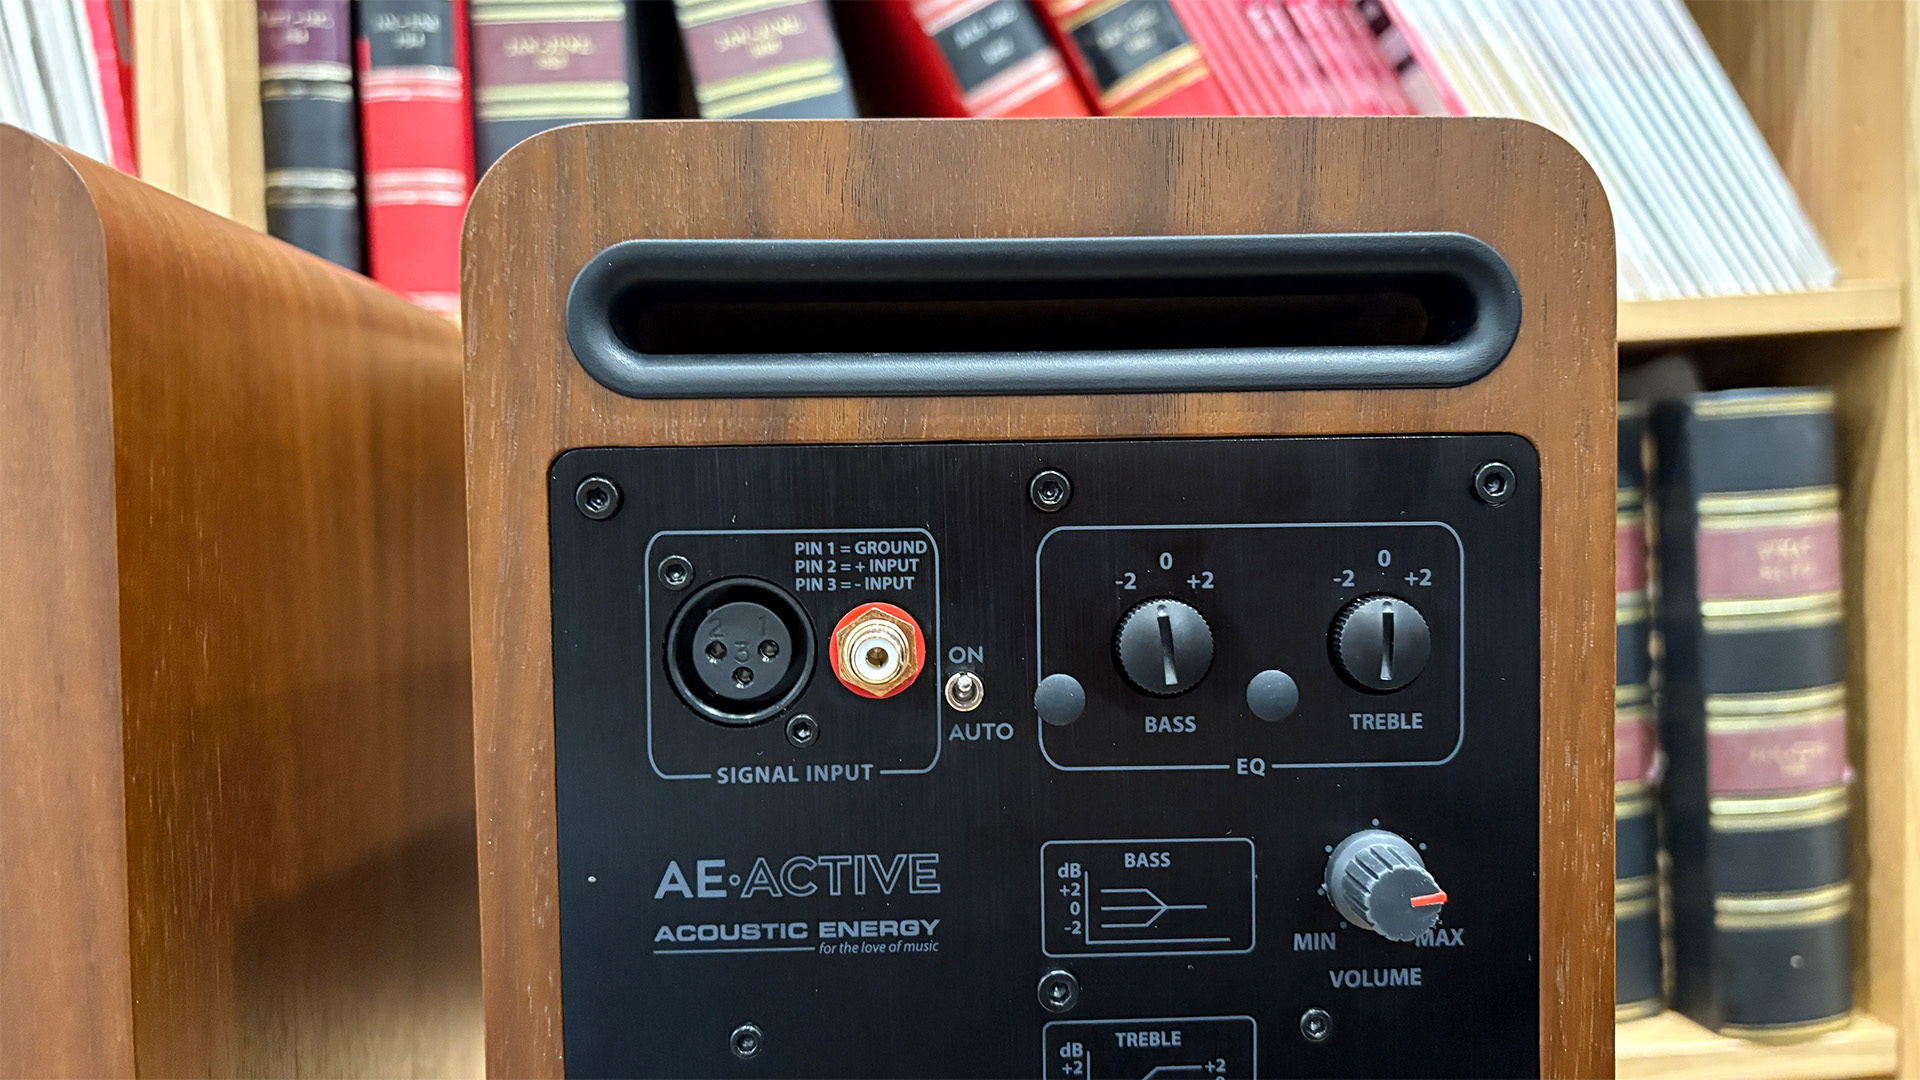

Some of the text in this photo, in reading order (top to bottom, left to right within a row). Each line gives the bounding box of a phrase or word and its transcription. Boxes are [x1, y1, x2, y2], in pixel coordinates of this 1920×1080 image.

[794, 540, 928, 556] PIN 1 = GROUND
[795, 558, 920, 574] PIN 2 = + INPUT
[1159, 552, 1173, 570] 0
[1377, 549, 1391, 568] 0
[795, 577, 823, 592] PIN
[827, 577, 837, 592] 3
[840, 581, 852, 589] =
[864, 576, 915, 591] INPUT
[1115, 572, 1137, 590] -2
[1186, 571, 1214, 589] +2
[1333, 569, 1355, 587] -2
[1404, 568, 1432, 587] +2
[708, 616, 724, 638] 2
[758, 614, 768, 637] 1
[733, 640, 750, 664] 3
[948, 645, 984, 664] ON
[1145, 715, 1197, 733] BASS
[1349, 712, 1424, 730] TREBLE
[948, 722, 1014, 741] AUTO
[717, 763, 874, 785] SIGNAL INPUT
[1237, 757, 1266, 777] EQ
[1124, 851, 1171, 868] BASS
[1057, 862, 1082, 879] dB
[1059, 882, 1081, 897] +2
[1069, 901, 1081, 916] 0
[654, 919, 941, 943] ACOUSTIC ENERGY
[1063, 920, 1082, 935] -2
[1293, 932, 1336, 952] MIN
[1415, 928, 1465, 947] MAX
[819, 939, 939, 955] for the love of music
[1328, 967, 1422, 989] VOLUME
[1114, 1030, 1182, 1048] TREBLE
[1059, 1041, 1084, 1058] dB
[1061, 1060, 1083, 1075] +2
[1204, 1058, 1226, 1073] +2
